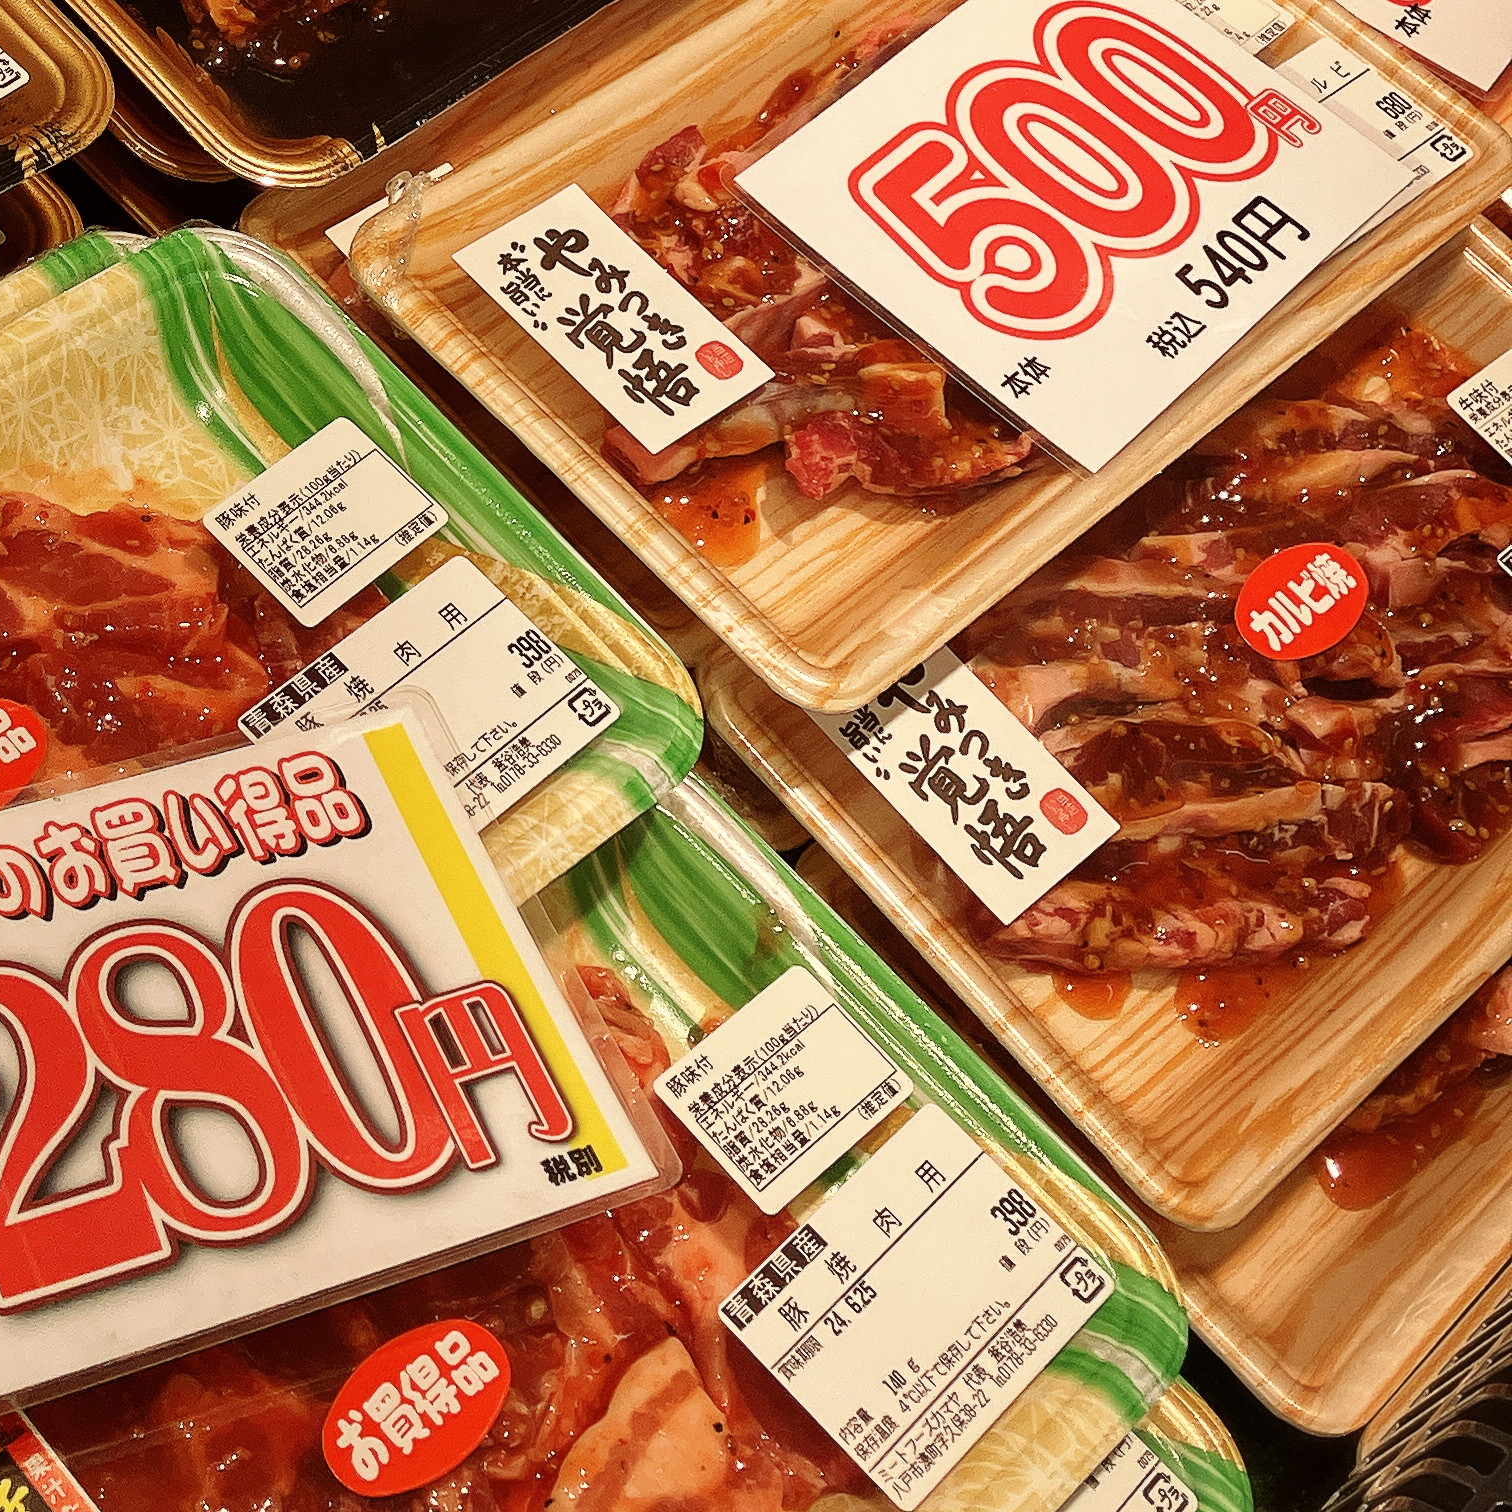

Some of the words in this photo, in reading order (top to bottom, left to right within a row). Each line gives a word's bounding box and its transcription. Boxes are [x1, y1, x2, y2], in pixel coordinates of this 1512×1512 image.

[1394, 2, 1434, 39] 本体
[1375, 92, 1414, 125] 680
[847, 0, 1323, 341] 500円
[1175, 195, 1310, 316] 540円
[533, 229, 687, 350] やみつき
[557, 293, 700, 415] 覚悟
[1146, 311, 1205, 362] 税込
[1001, 356, 1052, 403] 本体
[1459, 379, 1500, 412] 牛味付
[214, 493, 261, 530] 豚味付
[1249, 552, 1358, 652] カルビ焼
[295, 602, 468, 732] 豚焼肉用
[507, 630, 552, 668] 398
[242, 652, 349, 737] 青森県産
[899, 734, 1047, 879] 覚悟
[666, 1054, 714, 1099] 豚味付
[856, 1078, 902, 1120] (推定値)
[540, 1146, 603, 1185] 税別
[990, 1188, 1036, 1236] 398
[777, 1160, 947, 1331] 豚焼肉用
[720, 1223, 828, 1331] 青森県産
[882, 1370, 907, 1397] 140
[908, 1357, 921, 1373] g
[336, 1329, 499, 1480] お買得品
